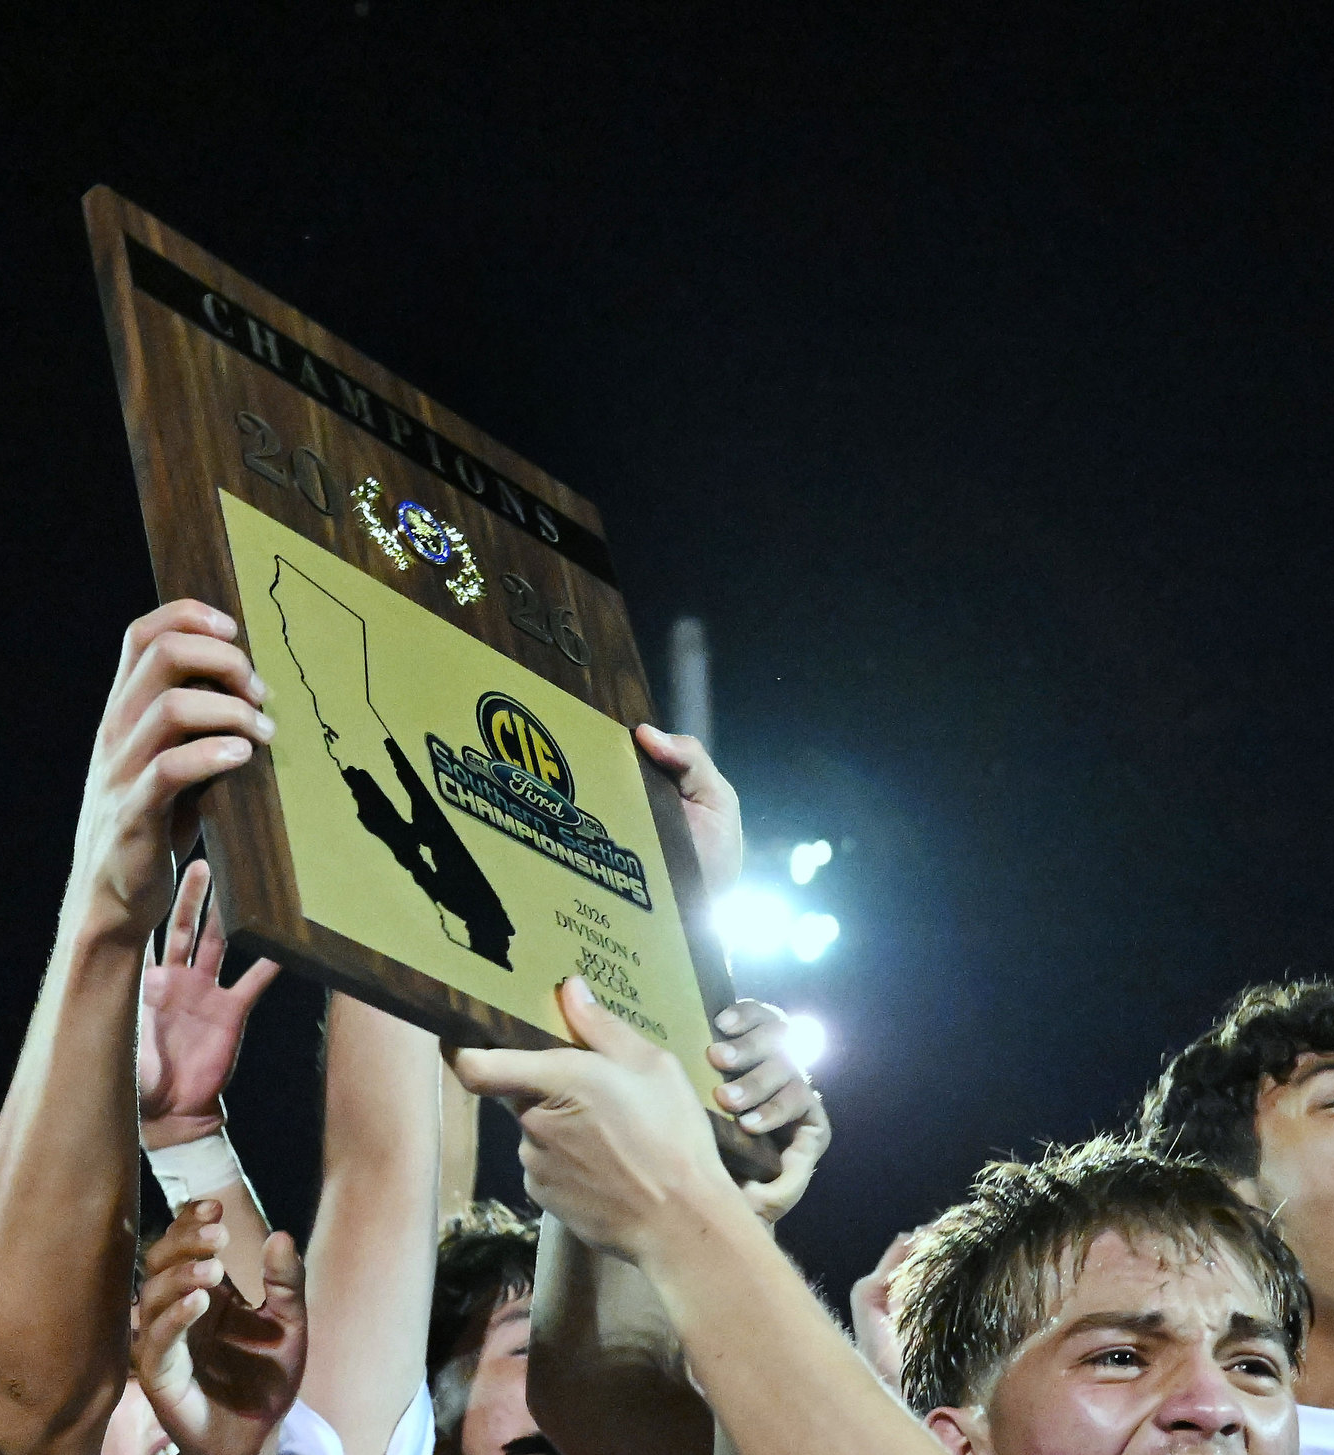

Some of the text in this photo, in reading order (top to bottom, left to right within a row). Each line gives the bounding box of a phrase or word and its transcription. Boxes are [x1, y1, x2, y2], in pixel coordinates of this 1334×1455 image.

[202, 293, 559, 544] CHAMPIONS
[235, 410, 591, 667] 20 26
[490, 709, 561, 787] CIF
[431, 741, 642, 878] Southern Section
[508, 771, 566, 819] Ford
[438, 771, 649, 905] CHAMPIONSHIPS
[555, 910, 641, 967] DIVISION 6
[573, 899, 611, 929] 2026
[575, 959, 641, 1004] SOCCER
[580, 945, 629, 983] BOYS
